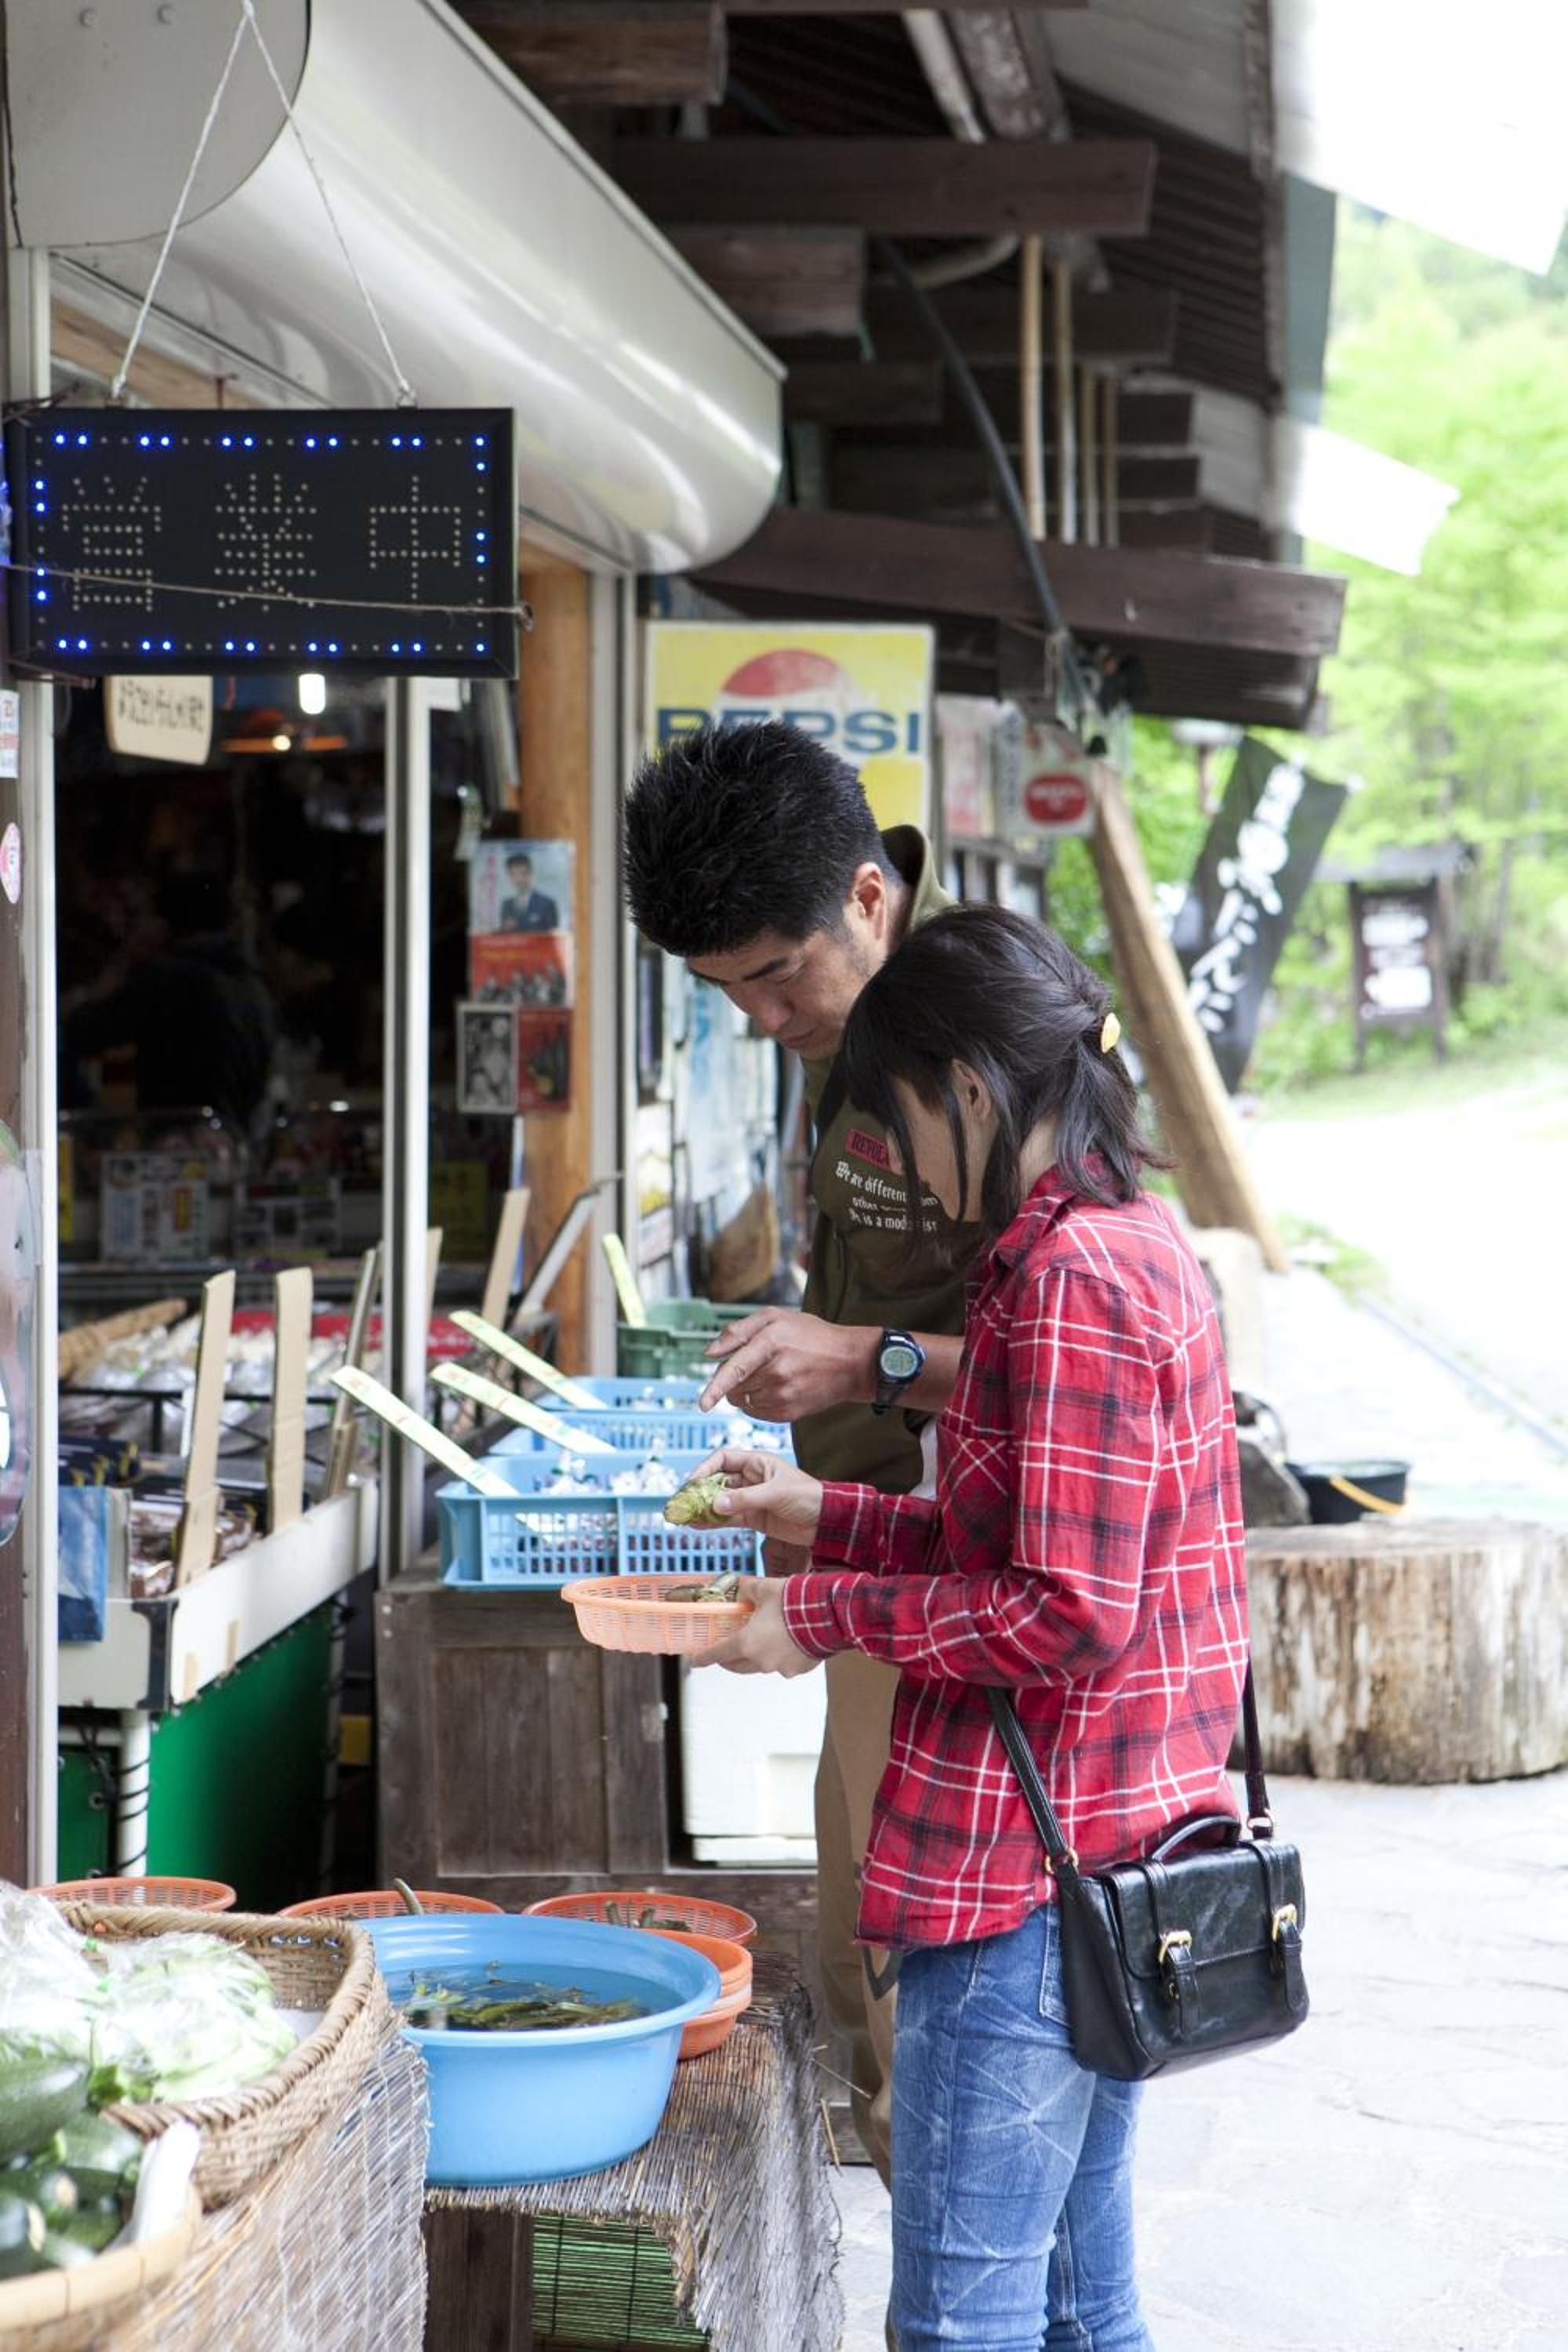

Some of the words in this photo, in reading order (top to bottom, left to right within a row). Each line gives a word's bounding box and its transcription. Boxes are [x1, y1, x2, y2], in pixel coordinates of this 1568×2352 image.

[63, 473, 463, 612] 営業中
[835, 1160, 851, 1182] We
[865, 1175, 906, 1203] different
[876, 1216, 882, 1228] a
